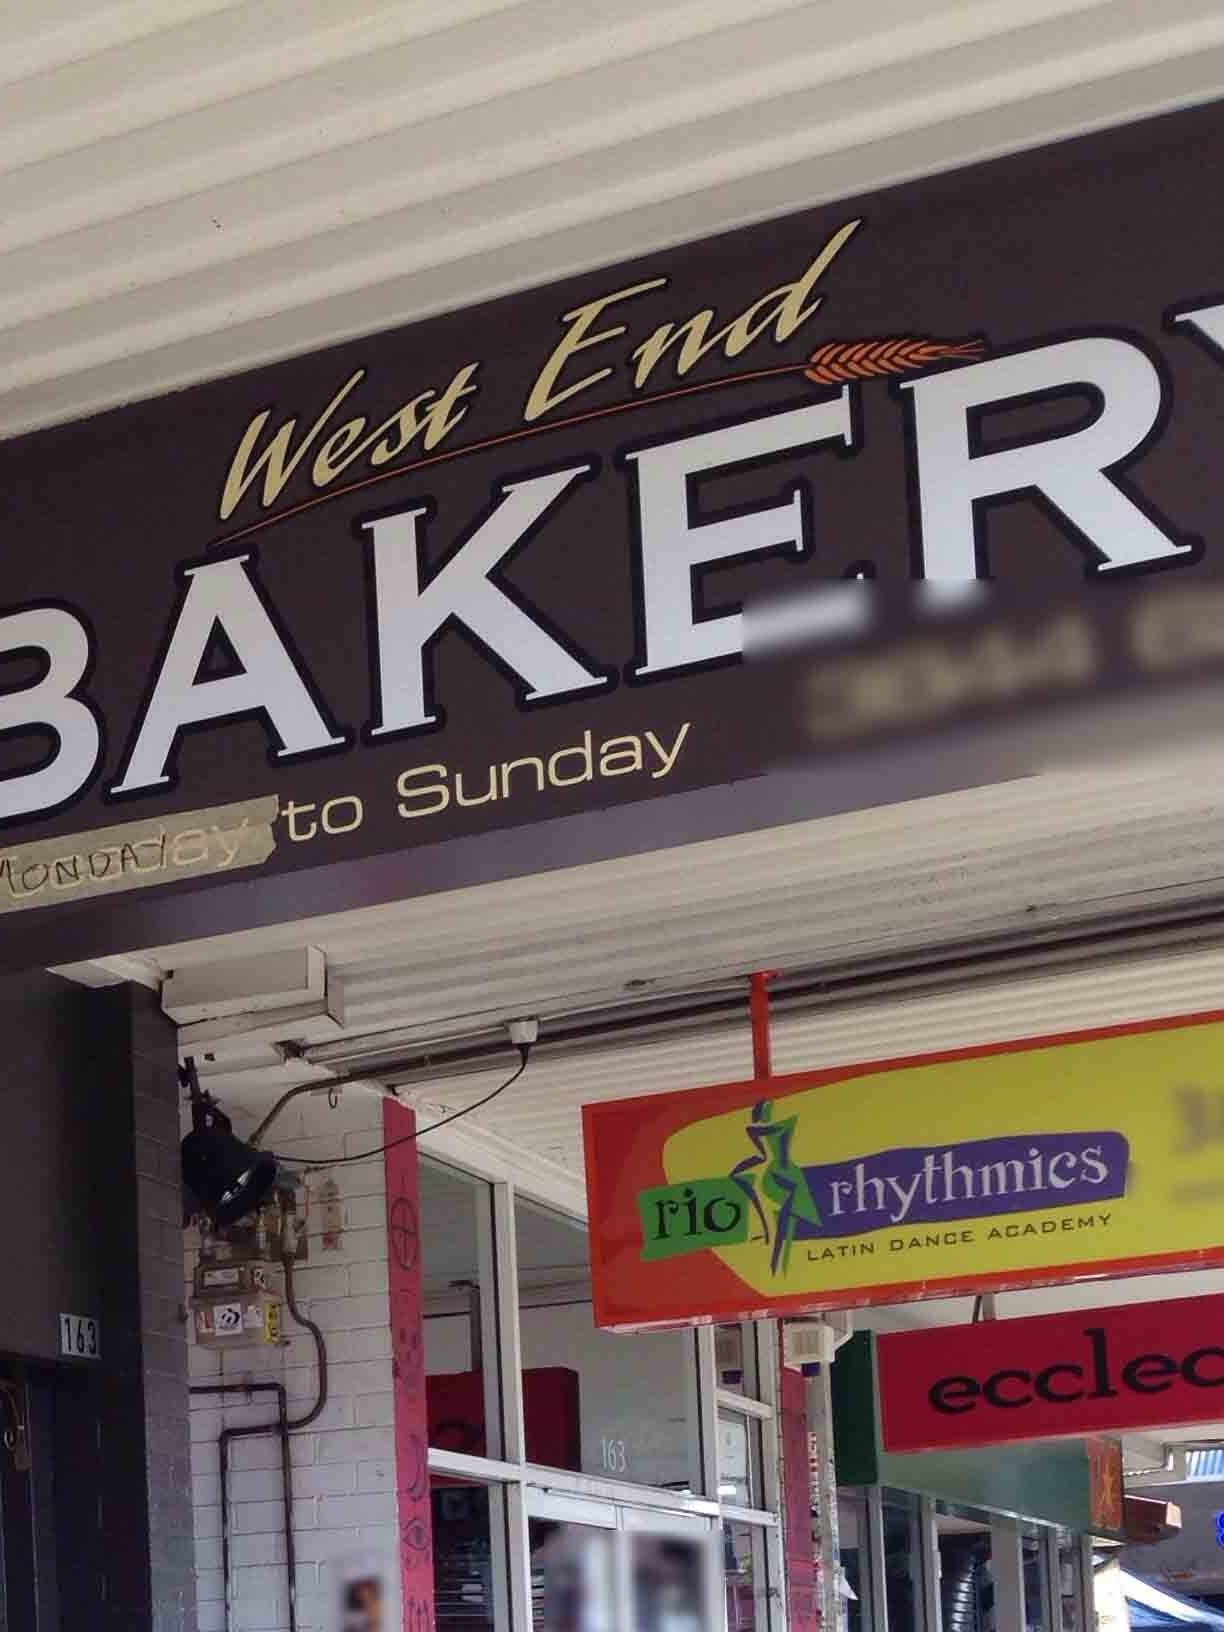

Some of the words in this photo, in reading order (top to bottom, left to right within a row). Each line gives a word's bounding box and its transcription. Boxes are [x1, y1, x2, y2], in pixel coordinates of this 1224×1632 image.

[220, 361, 479, 520] West
[524, 219, 863, 422] End
[279, 793, 364, 842] to
[397, 722, 691, 816] Sunday
[653, 1186, 743, 1241] rio
[829, 1143, 1110, 1224] rhythmics
[807, 1241, 875, 1262] LATIN
[889, 1230, 976, 1253] DANCE
[987, 1211, 1113, 1241] ACADEMY
[62, 1316, 98, 1356] 163
[599, 1437, 626, 1473] 163
